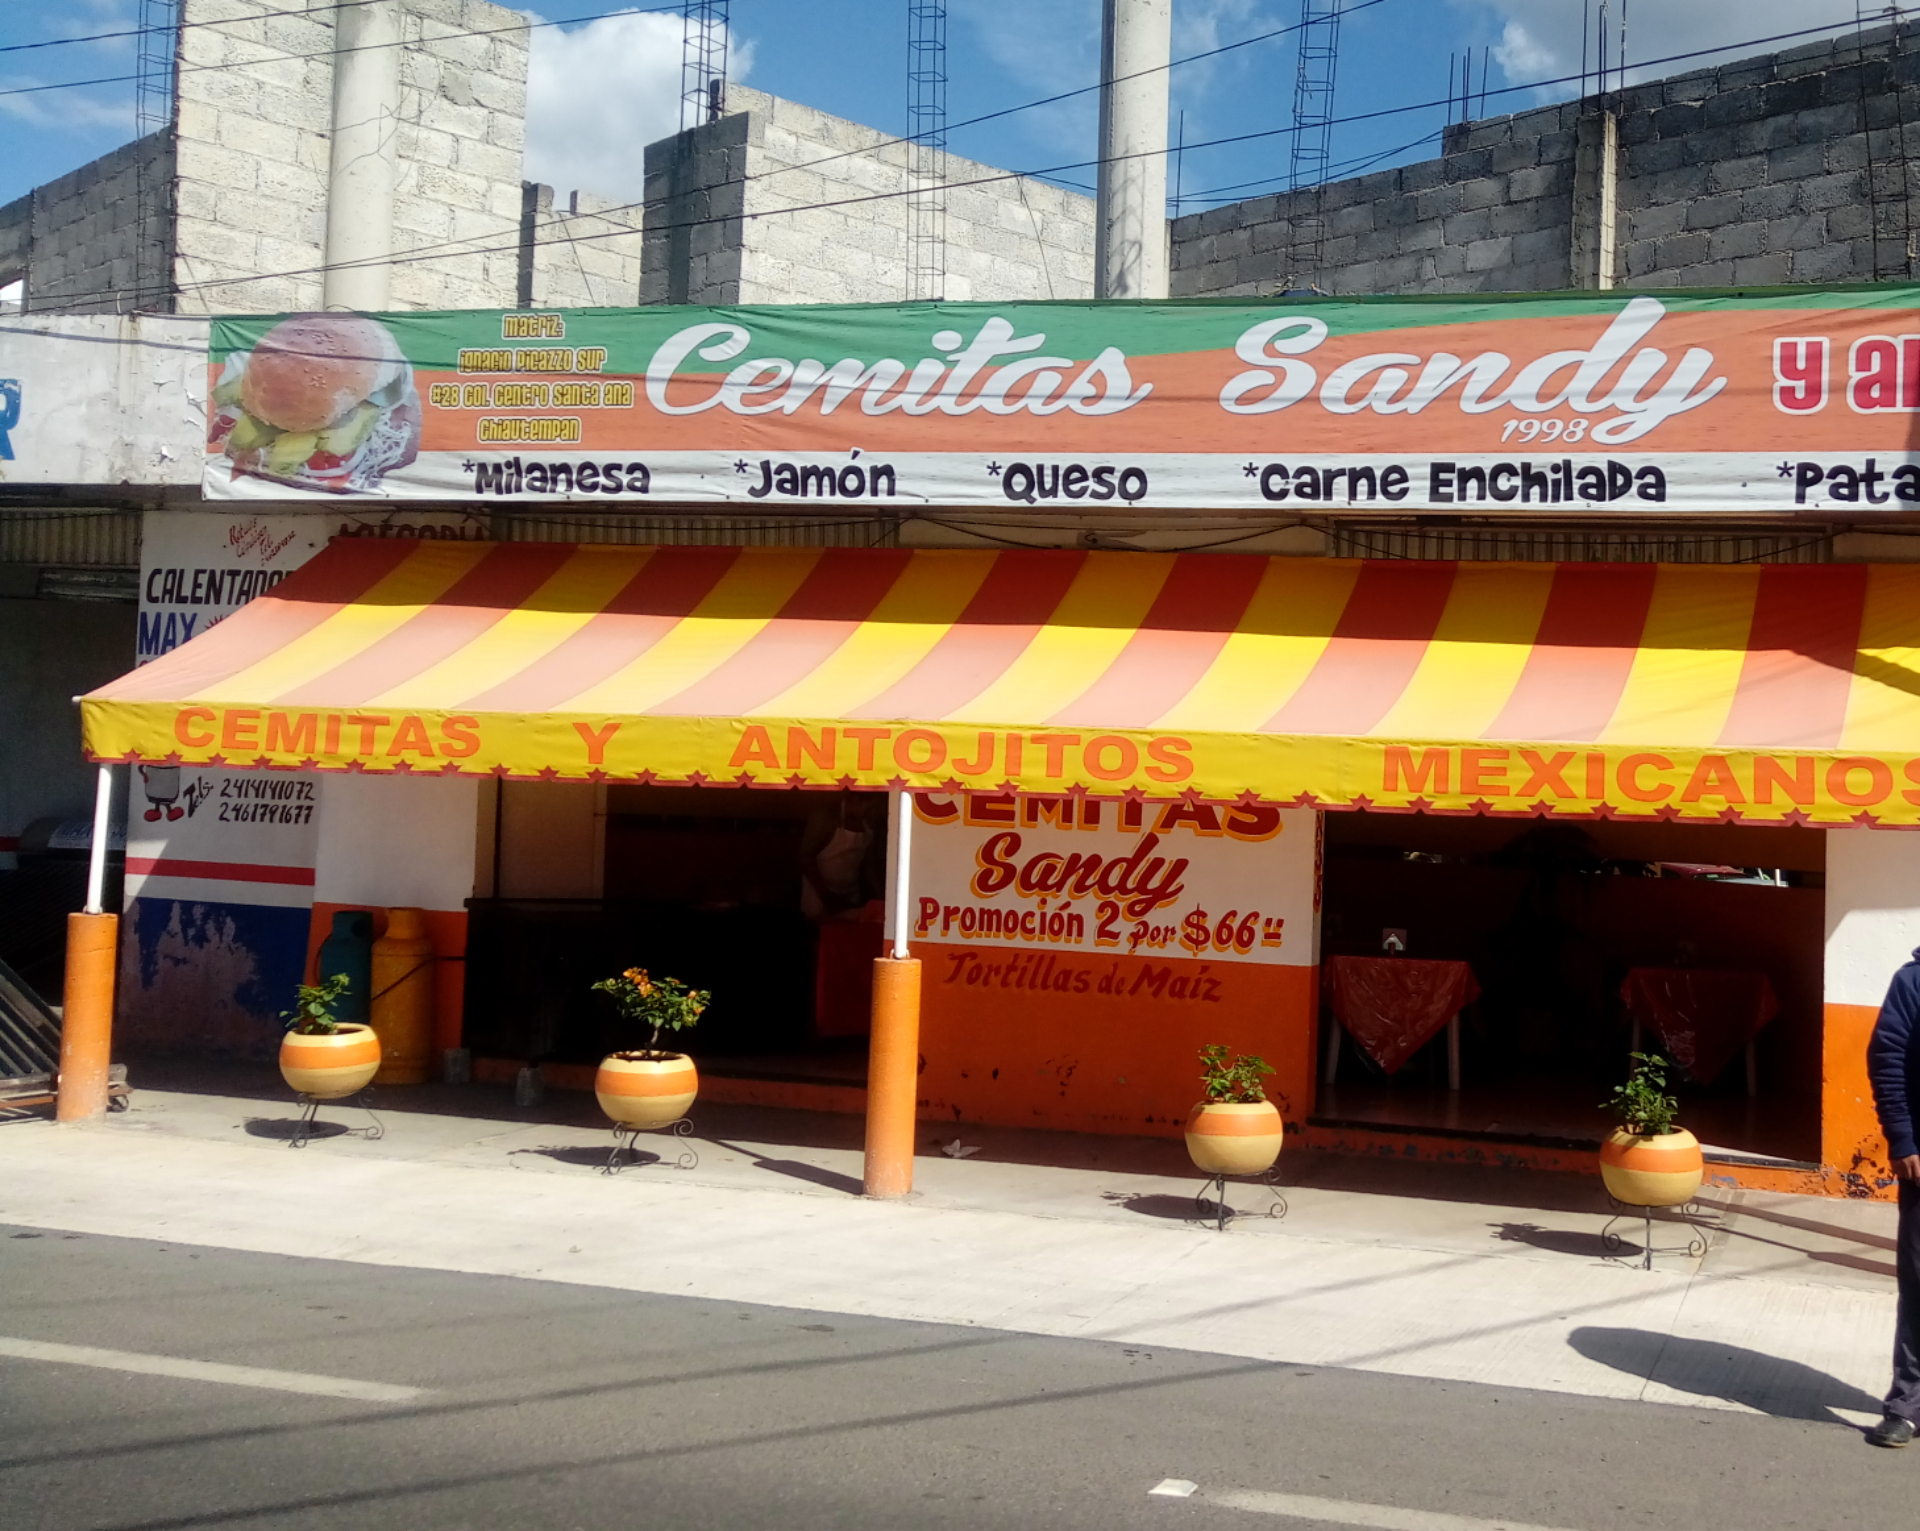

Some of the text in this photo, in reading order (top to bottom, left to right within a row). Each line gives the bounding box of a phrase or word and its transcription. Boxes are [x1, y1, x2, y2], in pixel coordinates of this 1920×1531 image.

[431, 384, 460, 407] #28
[645, 316, 1154, 417] Cemitas
[1218, 296, 1727, 445] Sandy
[1777, 339, 1826, 412] y
[1501, 418, 1586, 445] 1998
[146, 568, 297, 605] CALENTADO
[174, 707, 480, 758] CEMITAS
[573, 722, 622, 765] Y
[728, 725, 1194, 782] ANTOJITOS
[970, 832, 1189, 917] Sandy
[914, 897, 1084, 942] Promoción
[1094, 900, 1121, 948] 2
[944, 950, 1222, 1003] Tortillas de Maíz
